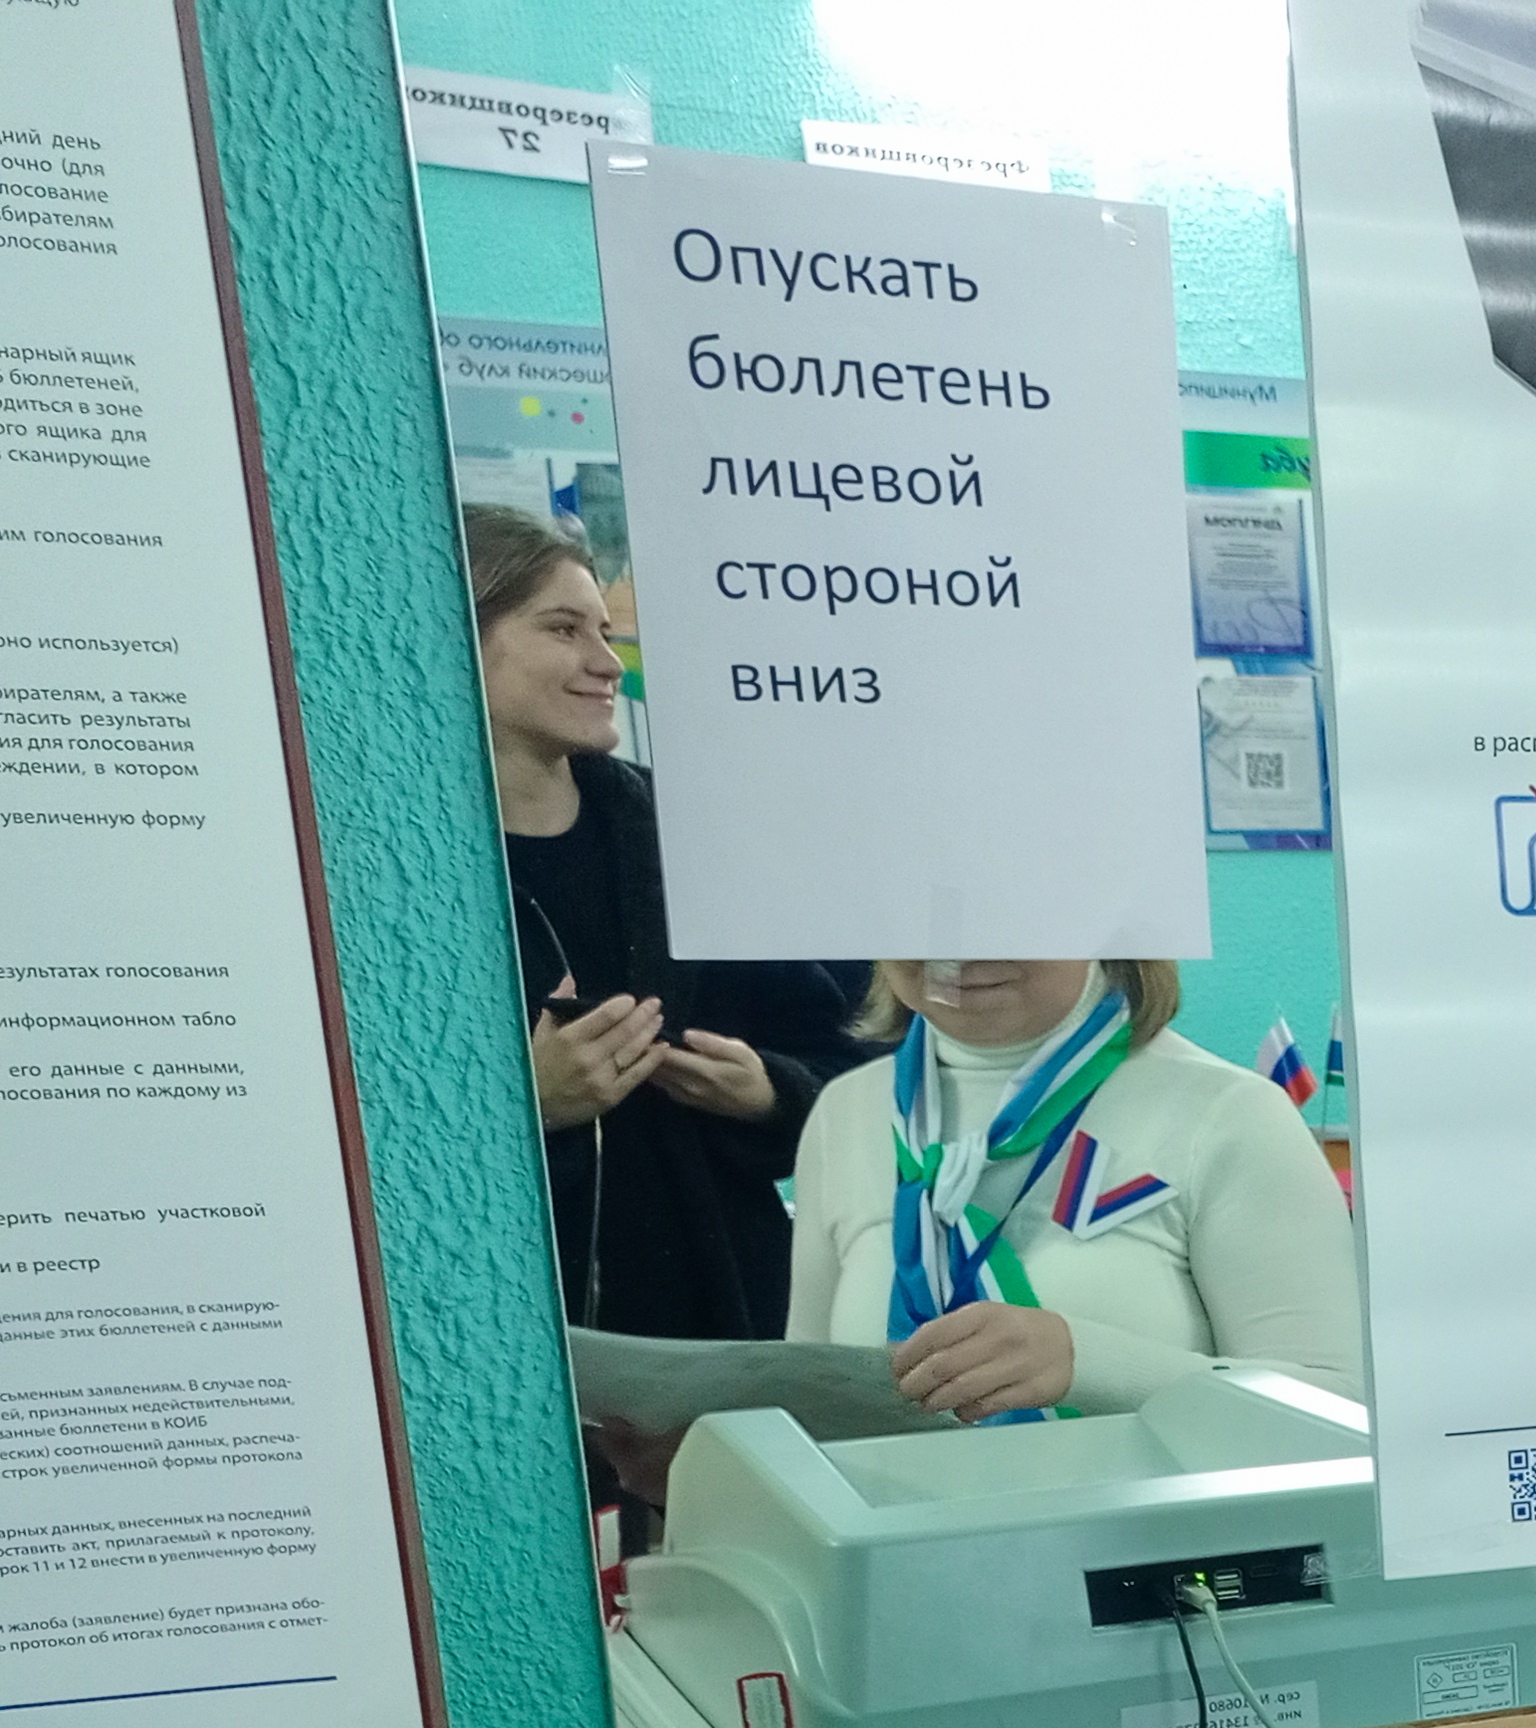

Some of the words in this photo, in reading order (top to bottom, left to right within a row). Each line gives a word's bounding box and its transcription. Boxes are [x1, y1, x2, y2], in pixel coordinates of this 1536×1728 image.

[52, 132, 102, 151] день
[61, 157, 105, 178] (для
[673, 228, 979, 303] Опускать
[81, 350, 137, 368] ящик
[9, 367, 140, 394] бюллетеней,
[688, 333, 1051, 410] бюллетень
[96, 402, 144, 418] зоне
[36, 424, 102, 441] ящика
[110, 429, 148, 445] для
[8, 448, 151, 469] сканирующие
[702, 453, 983, 512] лицевой
[34, 530, 164, 547] голосования
[715, 555, 1021, 616] стороной
[38, 635, 180, 655] используется)
[730, 663, 882, 704] вниз
[128, 690, 188, 705] также
[80, 713, 192, 731] результаты
[27, 737, 63, 752] для
[68, 738, 195, 752] голосования
[1474, 736, 1486, 752] в
[113, 763, 200, 779] котором
[1, 810, 136, 829] увеличенную
[141, 808, 206, 830] форму
[105, 965, 230, 979] голосования
[182, 1011, 237, 1027] табло
[9, 1063, 42, 1079] его
[50, 1061, 126, 1080] данные
[152, 1060, 245, 1077] данными,
[106, 1085, 131, 1099] по
[136, 1083, 221, 1101] каждому
[226, 1084, 248, 1098] из
[64, 1208, 147, 1224] печатью
[157, 1203, 267, 1223] участковой
[33, 1258, 101, 1276] реестр
[77, 1304, 184, 1320] голосования,
[132, 1395, 296, 1414] недействительными,
[59, 1419, 148, 1436] бюллетени
[163, 1415, 208, 1430] КОИБ
[51, 1458, 159, 1478] увеличенной
[162, 1454, 218, 1471] формы
[160, 1543, 264, 1566] увеличенную
[72, 1608, 165, 1630] (заявление)
[9, 1636, 86, 1652] протокол
